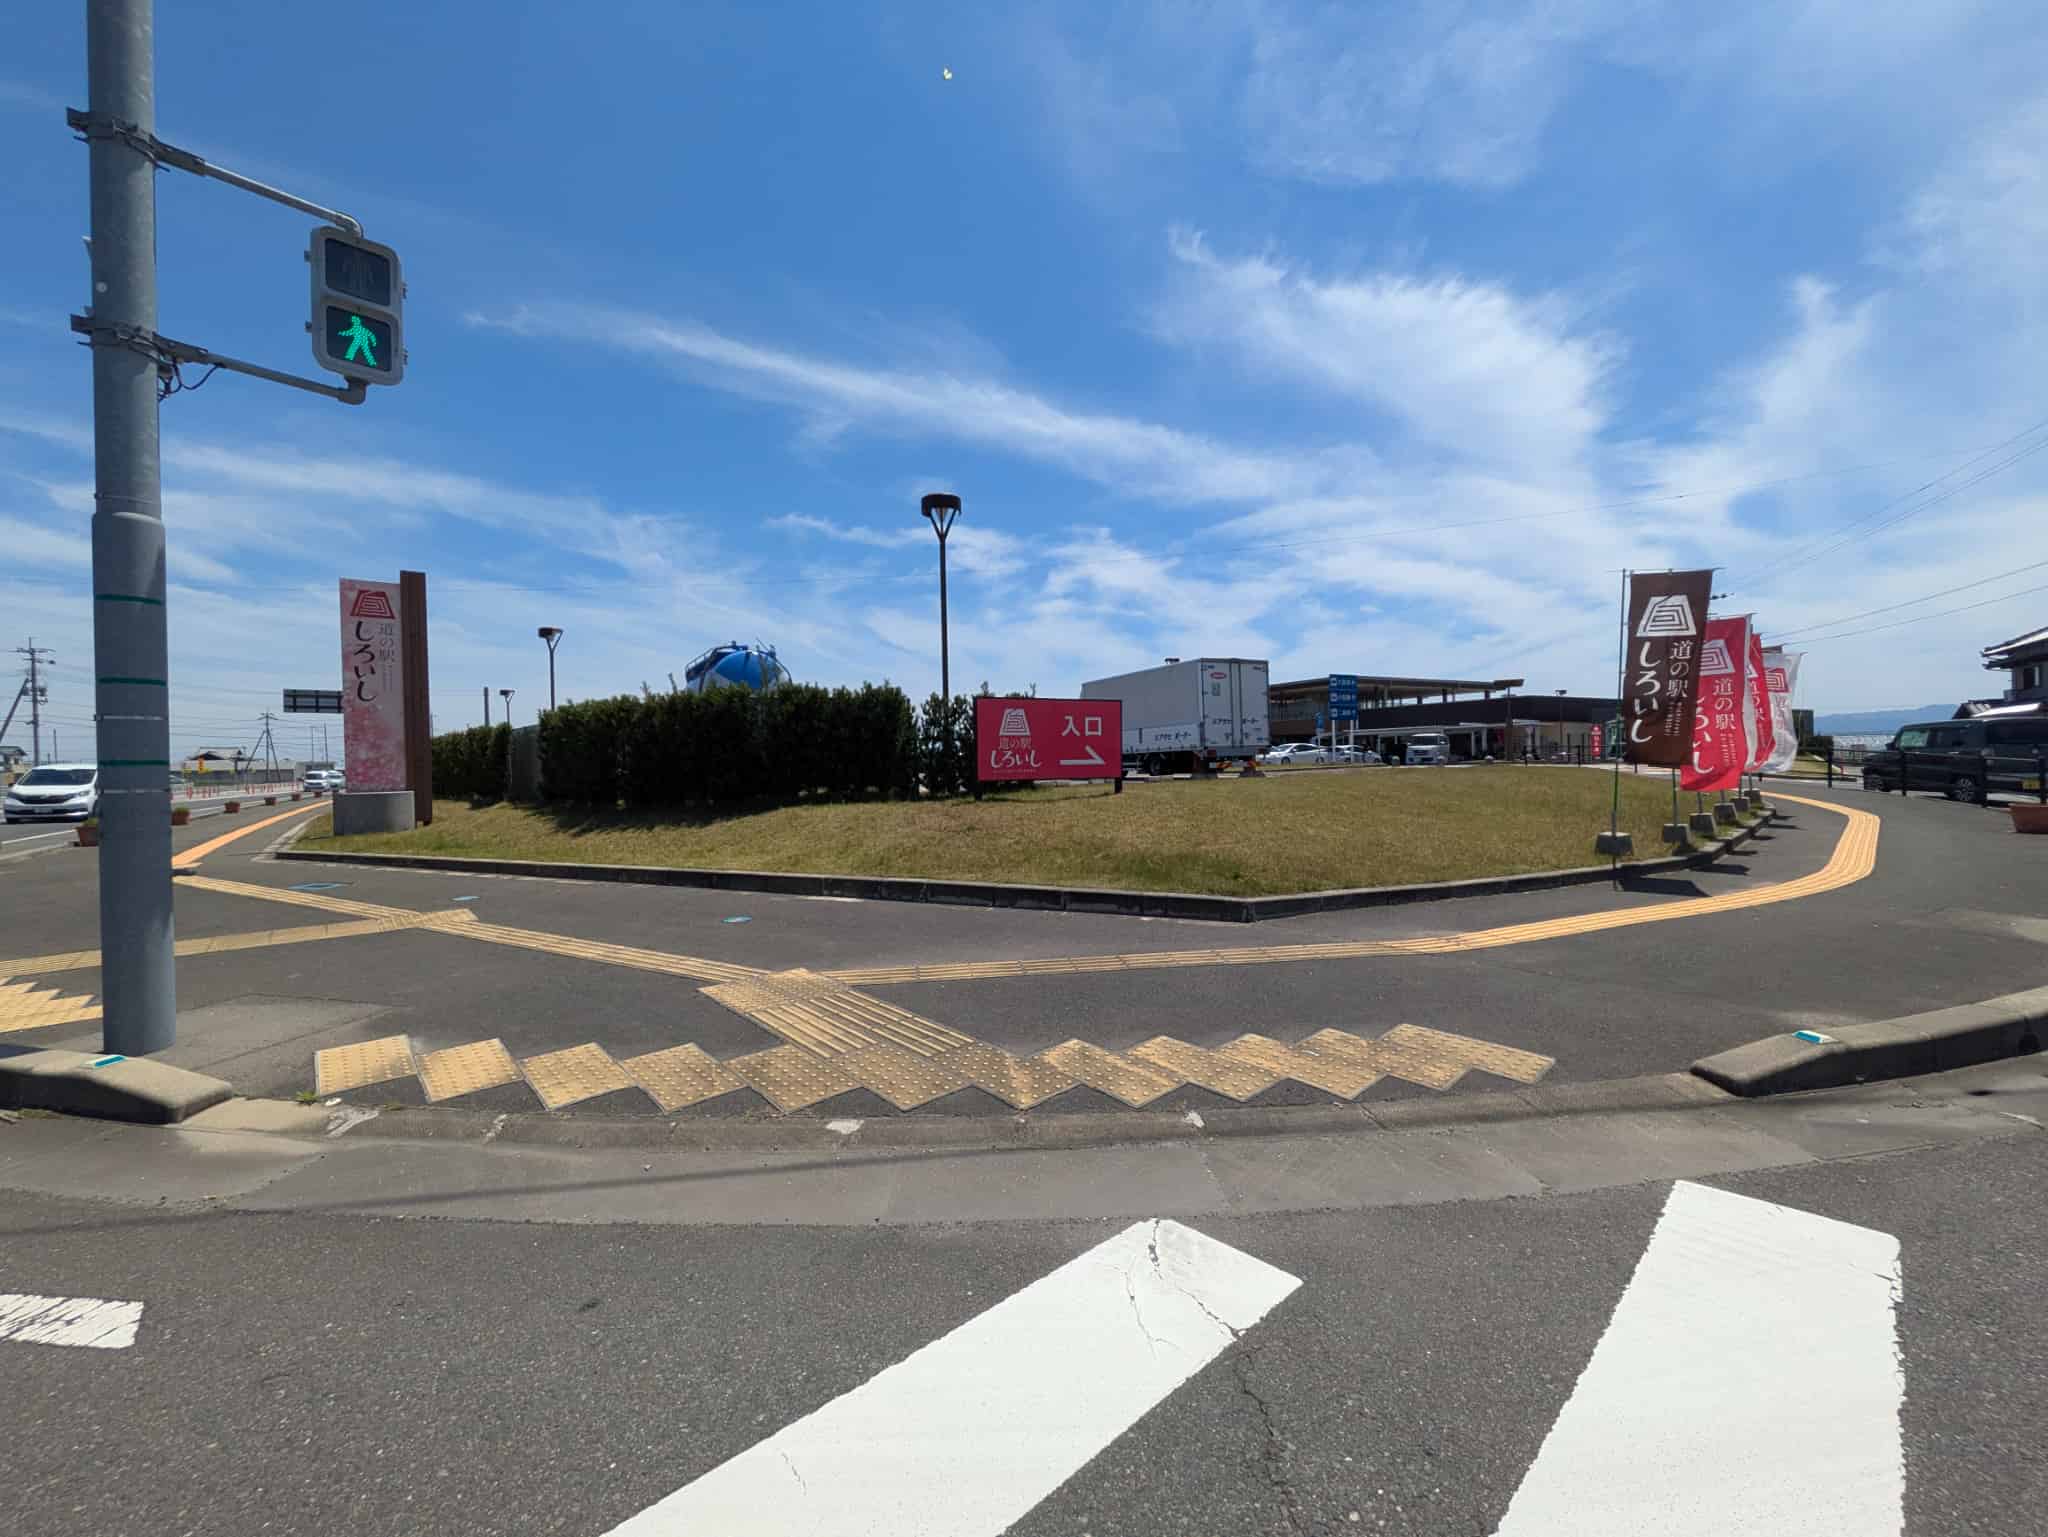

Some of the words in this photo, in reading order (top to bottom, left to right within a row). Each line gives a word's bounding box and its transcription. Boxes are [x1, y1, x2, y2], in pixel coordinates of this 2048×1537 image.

[353, 621, 377, 701] しろいし
[1666, 640, 1693, 698] 道の駅
[1631, 641, 1661, 743] しろいし
[1712, 678, 1735, 730] 道の駅
[998, 737, 1032, 750] 道の駅
[1061, 715, 1102, 737] 入口
[991, 750, 1042, 768] しろいし
